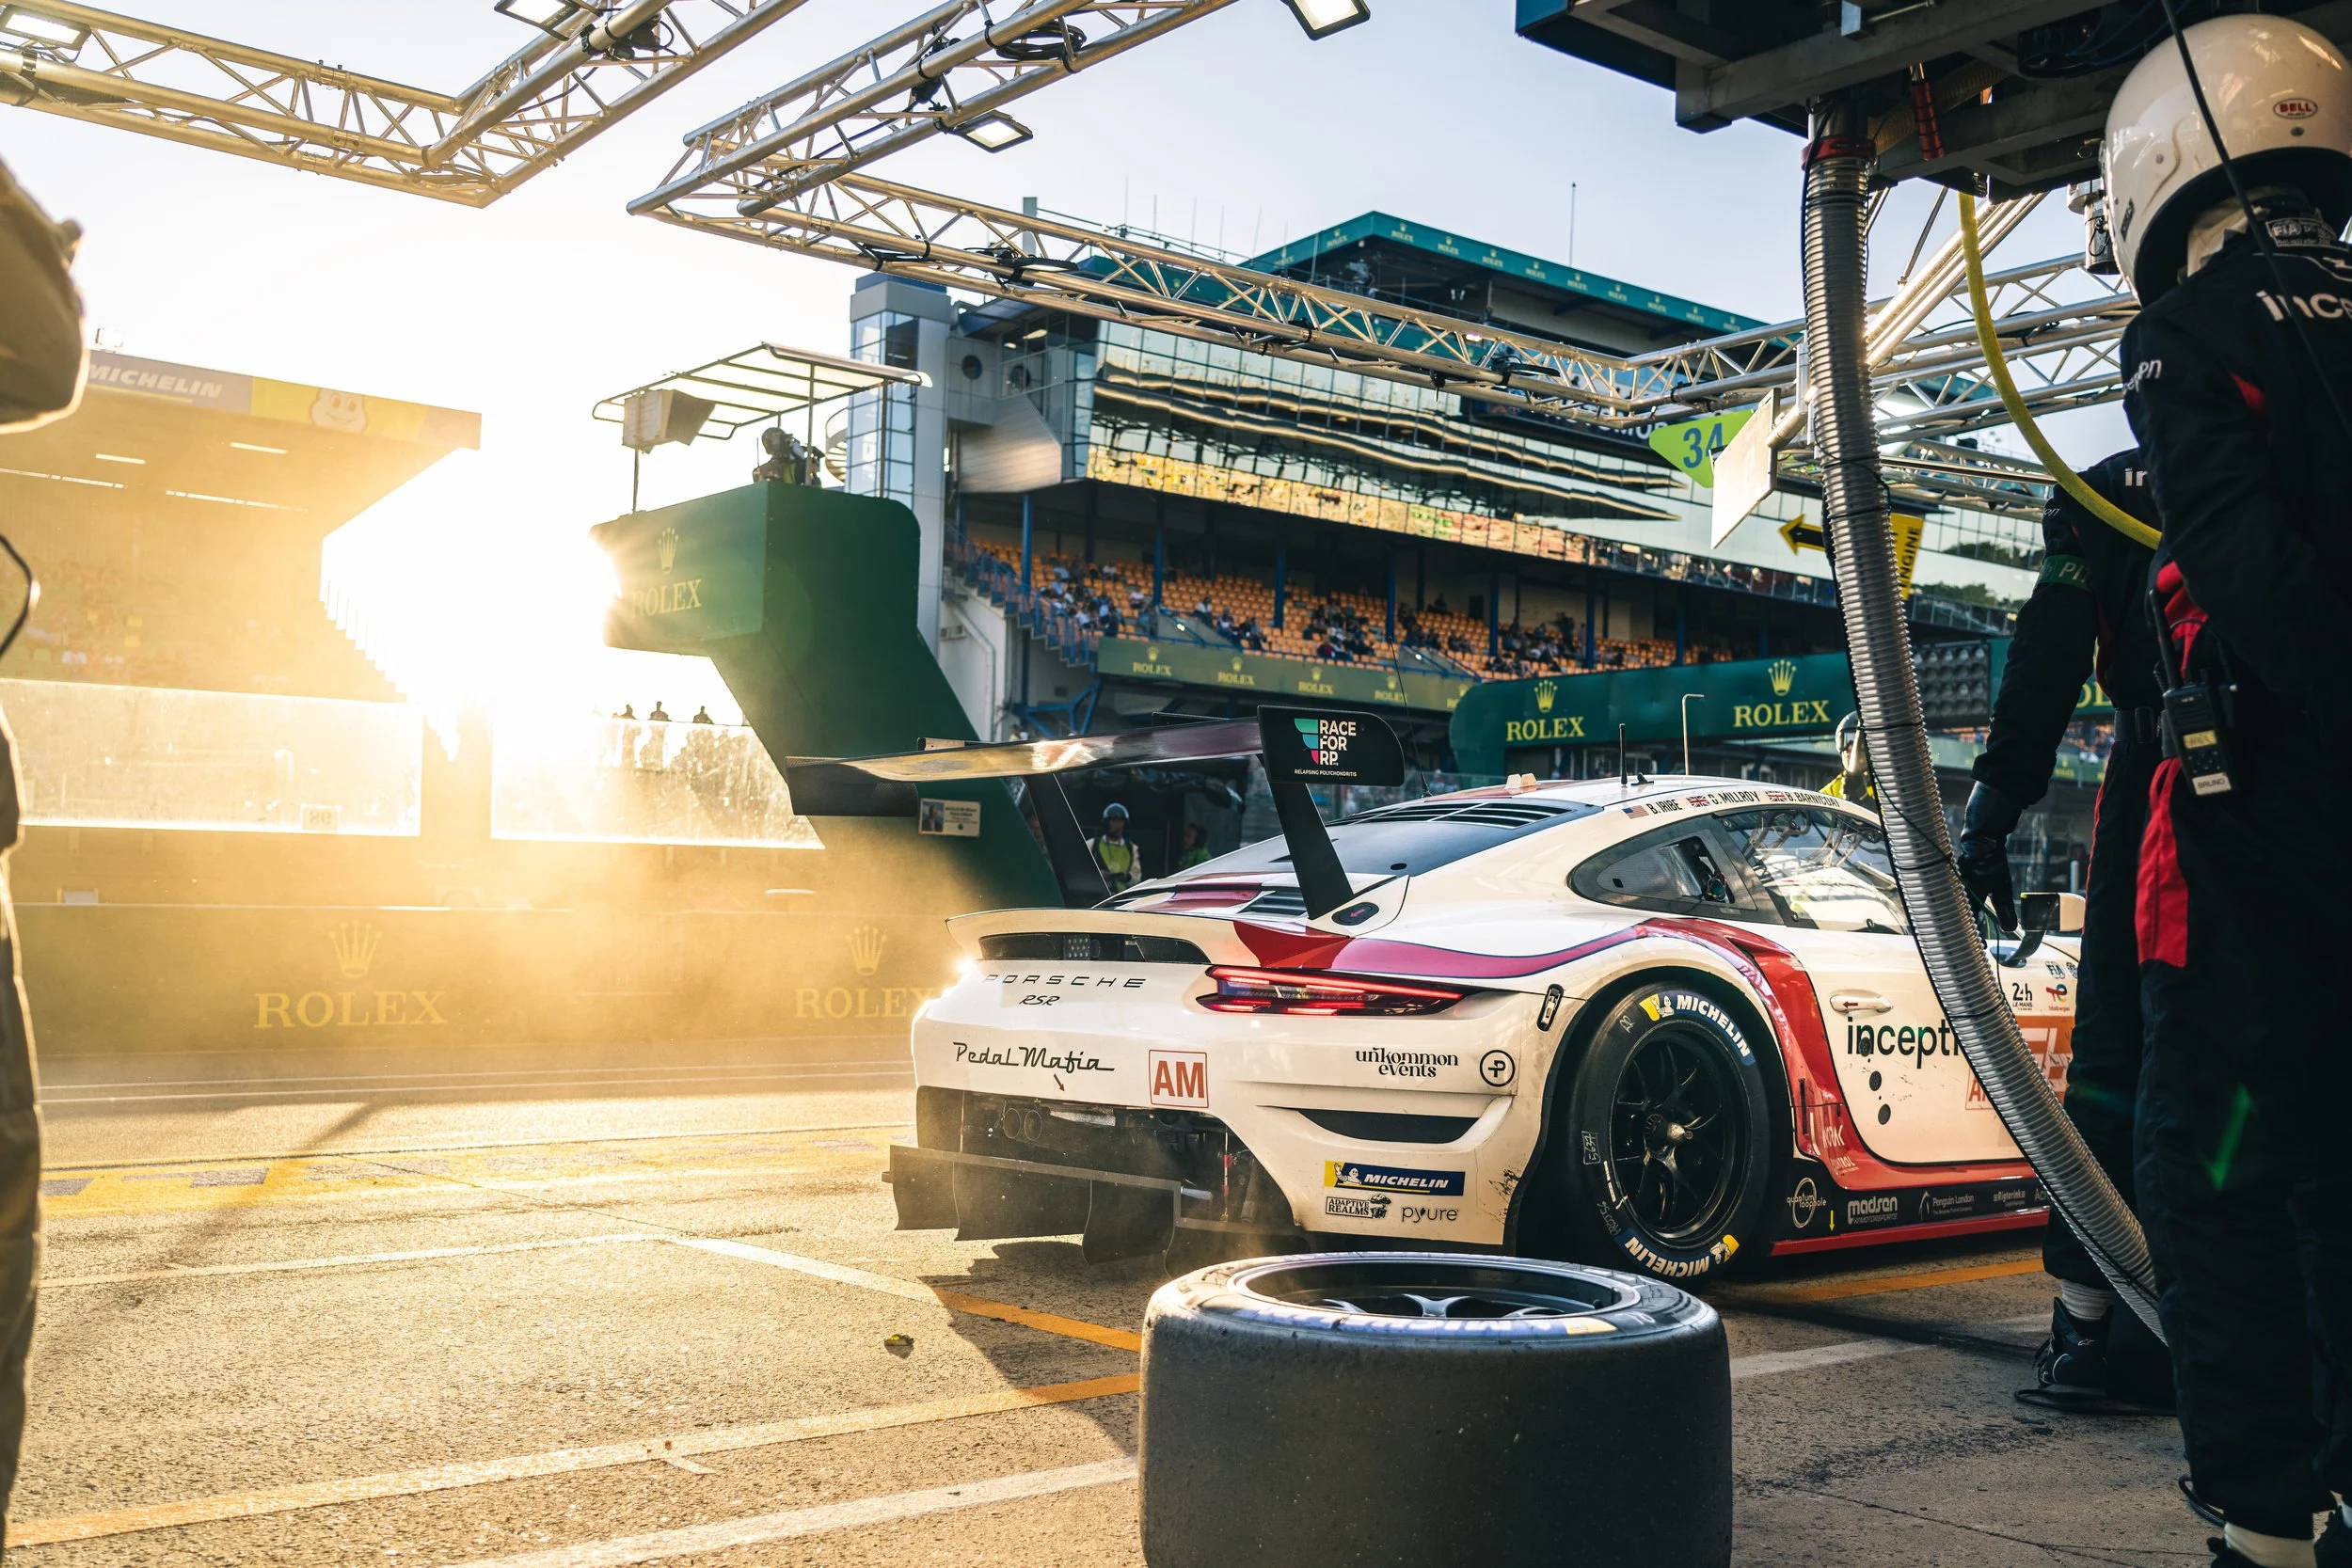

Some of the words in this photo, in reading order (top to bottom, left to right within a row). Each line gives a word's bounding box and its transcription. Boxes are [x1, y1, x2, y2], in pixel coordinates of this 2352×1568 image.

[2280, 102, 2312, 113] BELL
[2256, 290, 2352, 321] inc
[87, 364, 223, 399] MICHELIN
[1682, 422, 1724, 468] 34
[631, 578, 702, 619] ROLEX
[1133, 661, 1171, 676] ROLEX
[1217, 671, 1255, 686] ROLEX
[1298, 681, 1334, 695] ROLEX
[1375, 689, 1407, 703] ROLEX
[1733, 700, 1831, 728] ROLEX
[1319, 719, 1357, 736] RACE
[1506, 717, 1585, 741] ROLEX
[1319, 735, 1347, 751] FOR
[2198, 778, 2225, 789] BRUNO
[985, 974, 1146, 989] PORSCHE
[1019, 995, 1060, 1006] RSR
[254, 991, 448, 1029] ROLEX
[1677, 994, 1750, 1058] MICHELIN
[953, 1042, 1019, 1066] Pedal
[1019, 1046, 1115, 1073] Mafia
[1378, 1062, 1437, 1078] events
[1153, 1060, 1205, 1099] AM
[1363, 1173, 1449, 1188] MICHELIN
[1328, 1198, 1370, 1209] ADAPTIVE
[1787, 1193, 1815, 1206] quantum
[1799, 1197, 1827, 1210] loophole
[1932, 1196, 1955, 1208] Penguin
[1955, 1194, 1975, 1205] London
[1328, 1204, 1370, 1216] REALMS
[1401, 1206, 1457, 1223] pyure
[1848, 1196, 1898, 1225] madsen
[1624, 1236, 1709, 1277] MICHELIN
